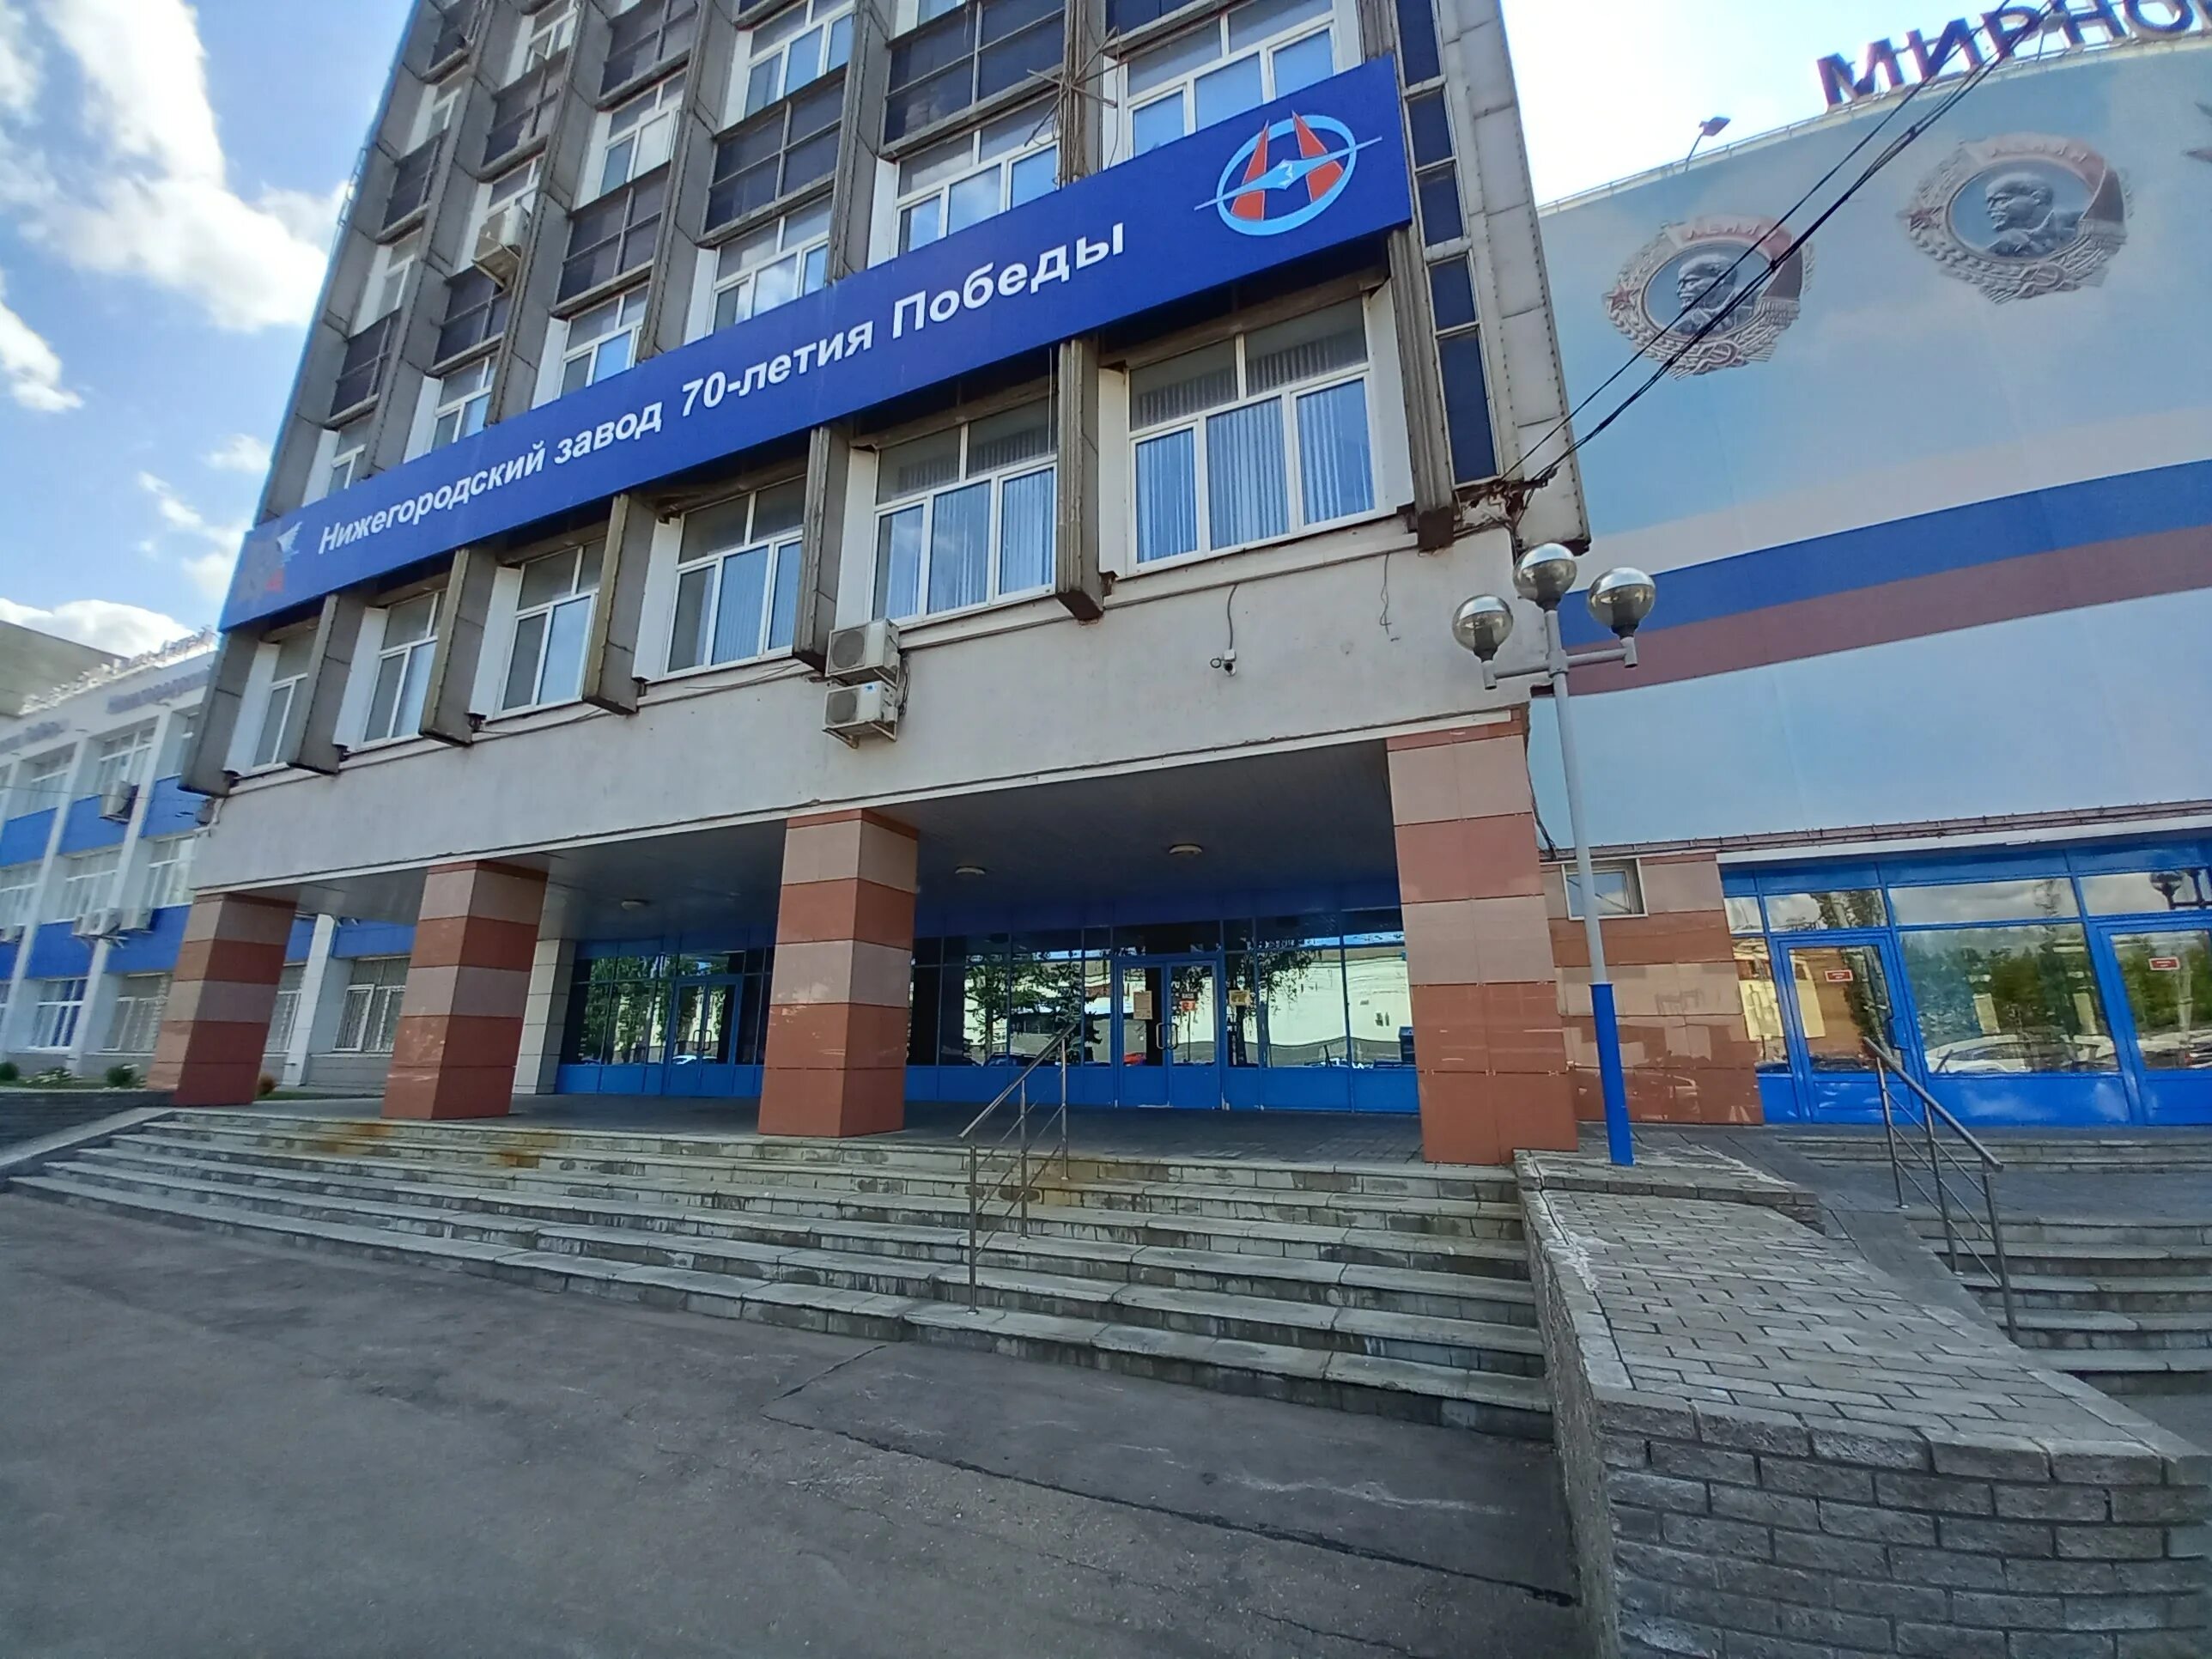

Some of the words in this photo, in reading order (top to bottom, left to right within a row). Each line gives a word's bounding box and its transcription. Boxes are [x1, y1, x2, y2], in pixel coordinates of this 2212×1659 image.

[1817, 0, 2212, 109] МИРНО
[318, 442, 547, 555] Нижегородский
[554, 401, 663, 464] завод
[681, 319, 874, 417] 70-летия
[891, 222, 1125, 339] Победы
